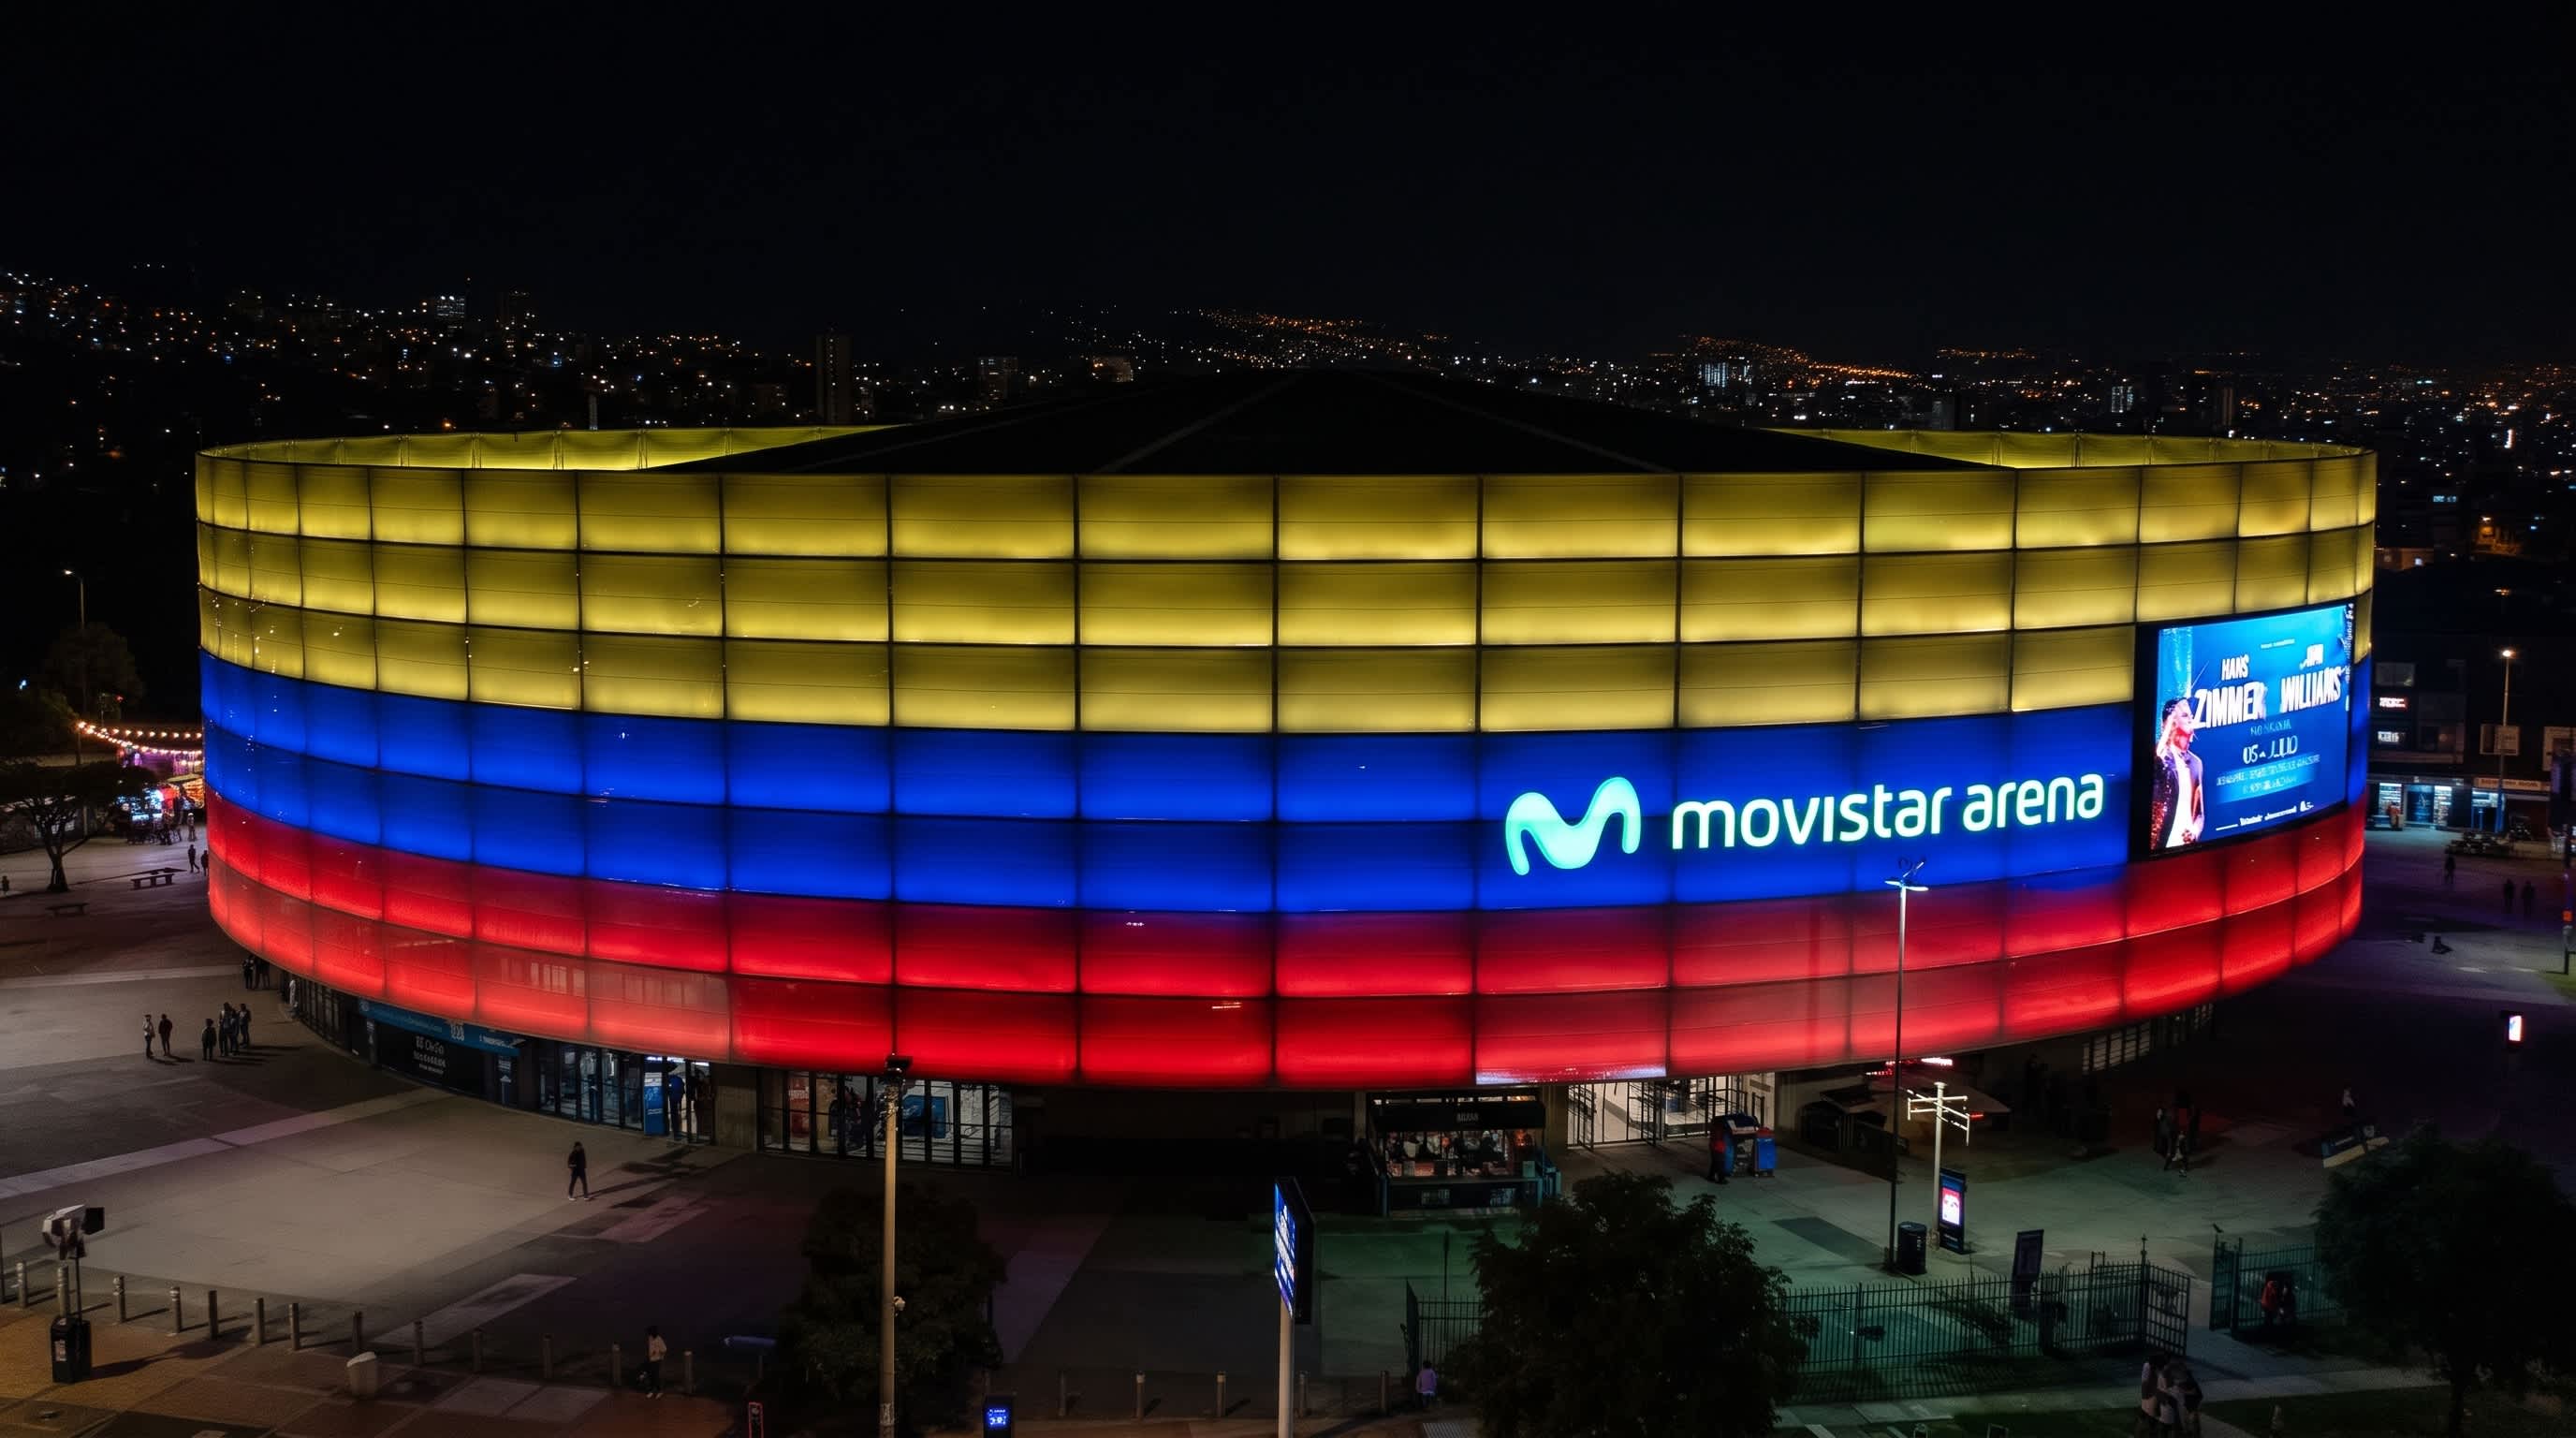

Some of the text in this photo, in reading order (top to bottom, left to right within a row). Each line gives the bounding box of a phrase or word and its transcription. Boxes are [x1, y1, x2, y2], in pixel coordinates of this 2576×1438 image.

[2221, 653, 2249, 682] HANS
[1671, 783, 1954, 851] movistar
[1961, 772, 2105, 833] arena
